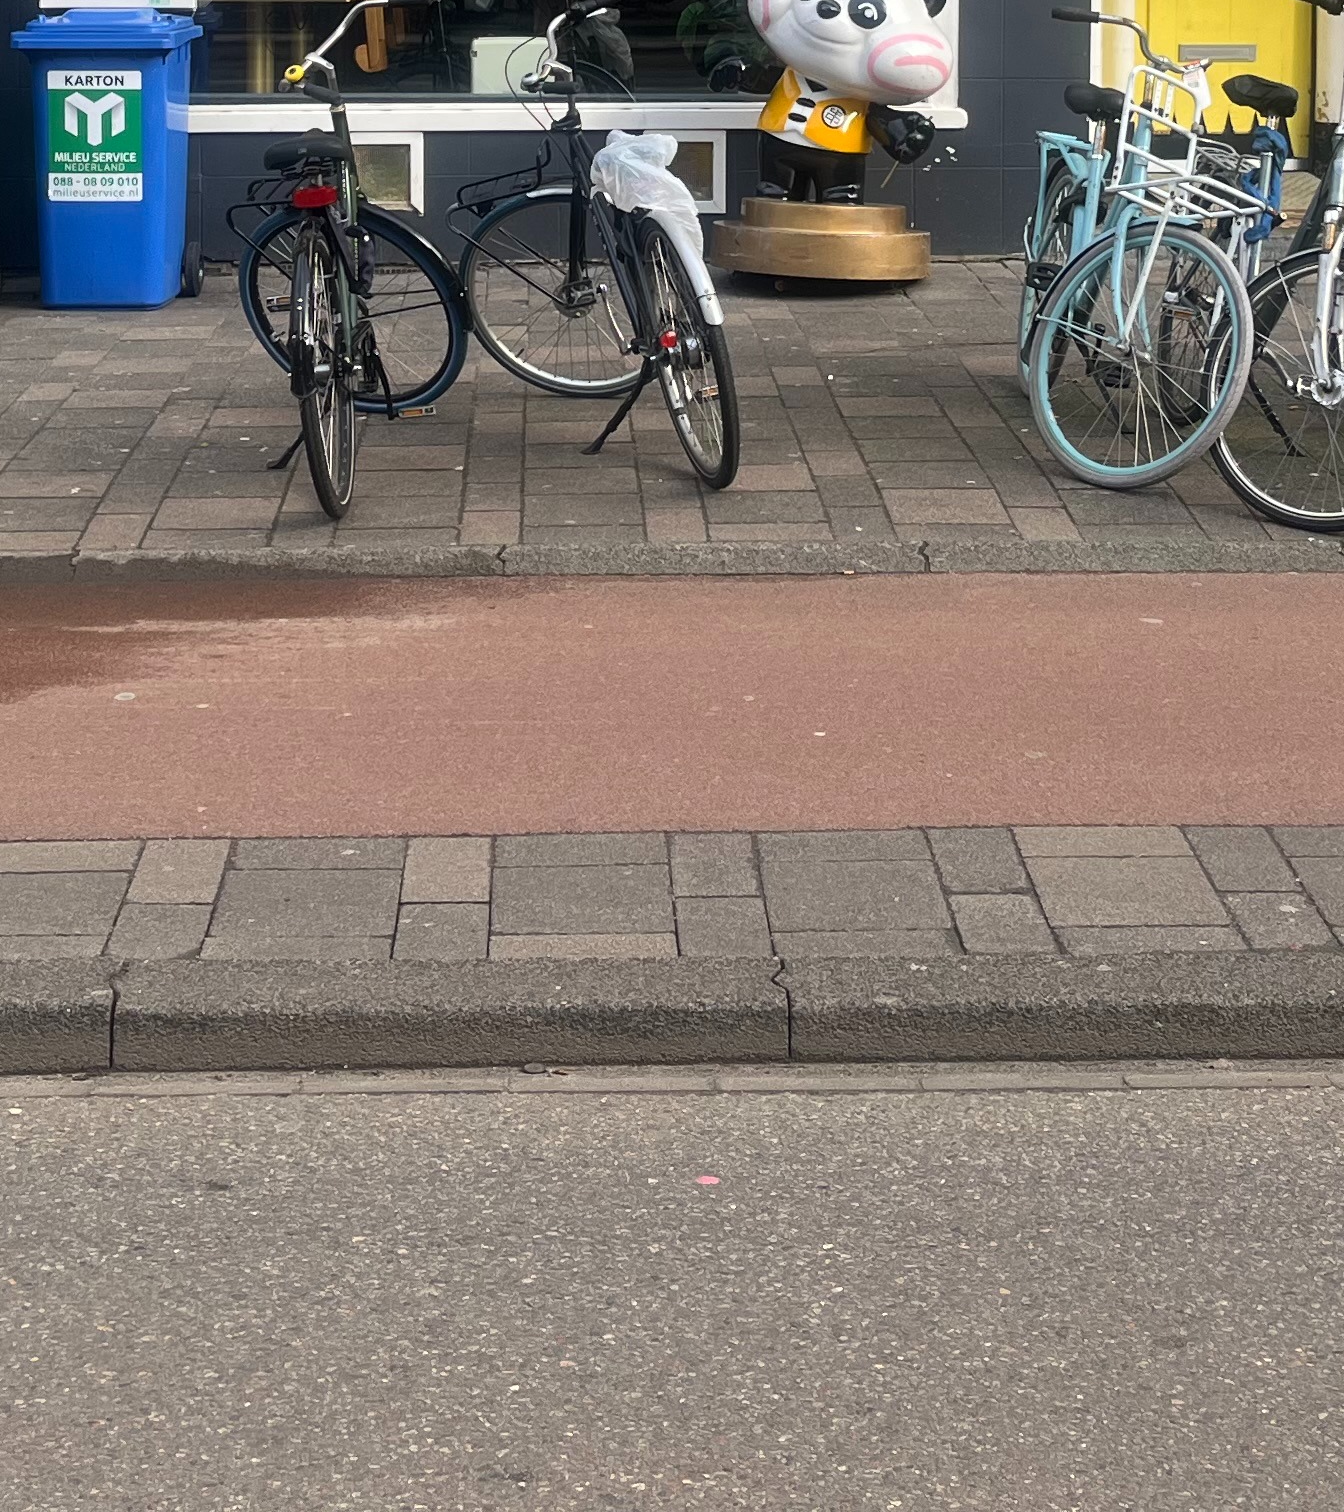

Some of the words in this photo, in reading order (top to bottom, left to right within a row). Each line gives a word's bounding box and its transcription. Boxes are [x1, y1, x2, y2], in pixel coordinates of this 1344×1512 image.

[64, 75, 125, 87] KARTON
[54, 152, 90, 163] MILIEU
[92, 152, 137, 162] SERVICE
[64, 163, 126, 172] NEDERLAND
[53, 177, 73, 186] 088
[84, 177, 97, 186] 08
[100, 177, 114, 186] 09
[117, 177, 138, 186] 010
[53, 188, 138, 198] milieuservice.nl
